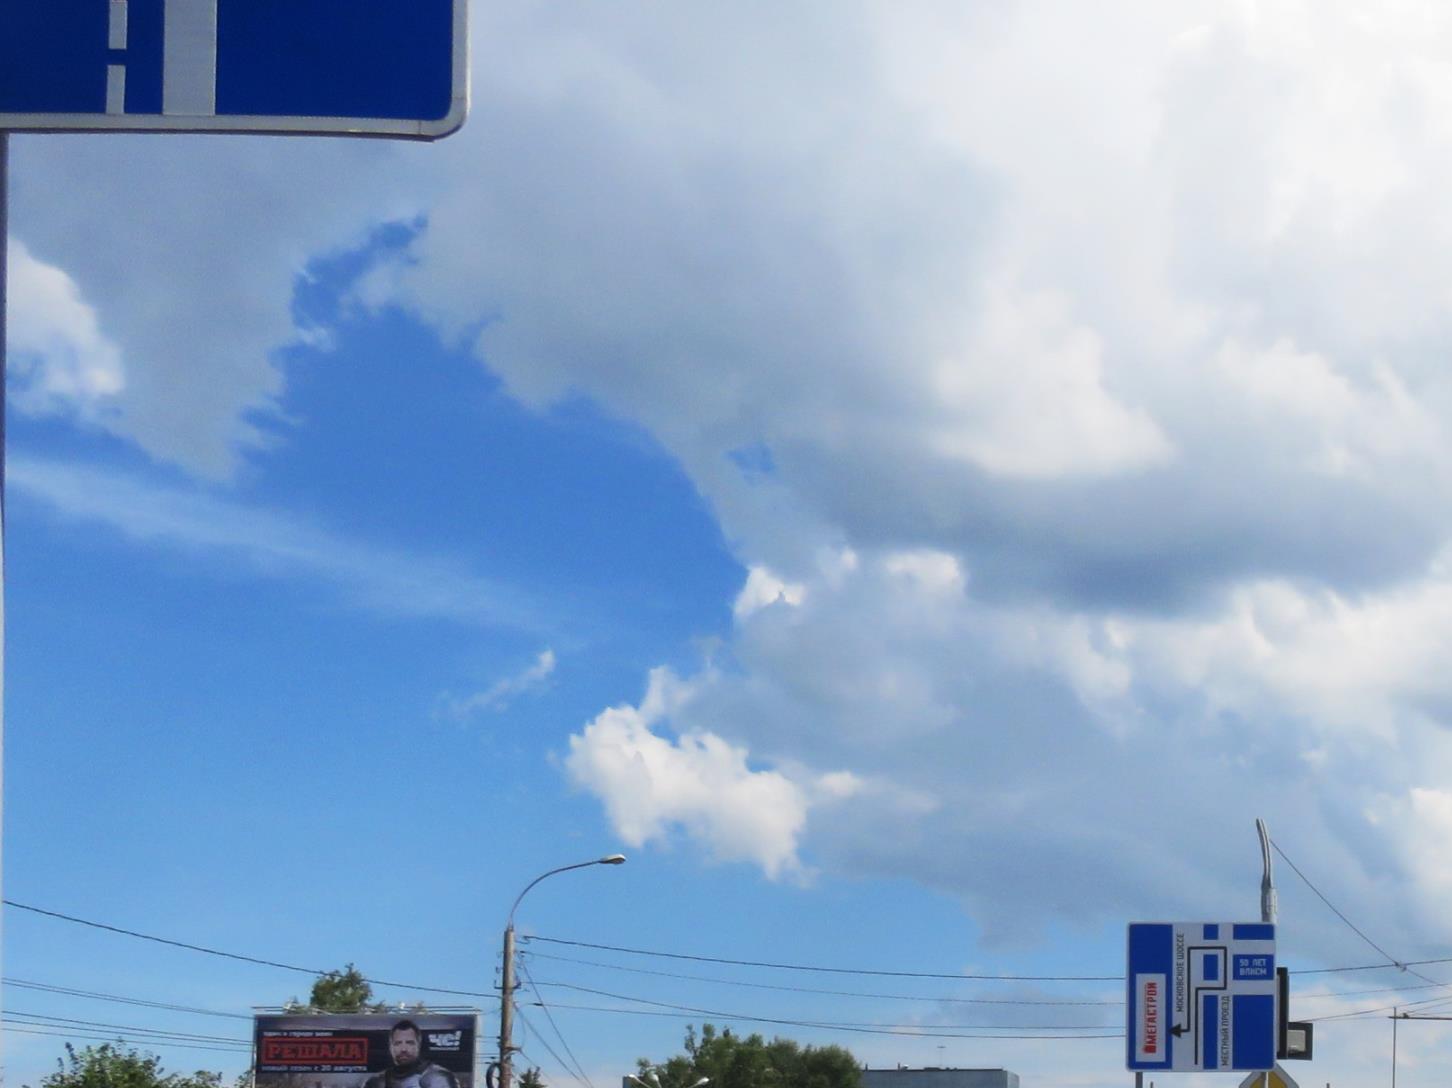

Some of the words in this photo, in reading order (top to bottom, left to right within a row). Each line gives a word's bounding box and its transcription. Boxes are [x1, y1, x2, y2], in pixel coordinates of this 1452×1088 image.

[1176, 933, 1185, 960] ШОССЕ
[1176, 961, 1185, 1012] МОСКОВСКОЕ
[267, 1043, 362, 1060] РЕШАЛА
